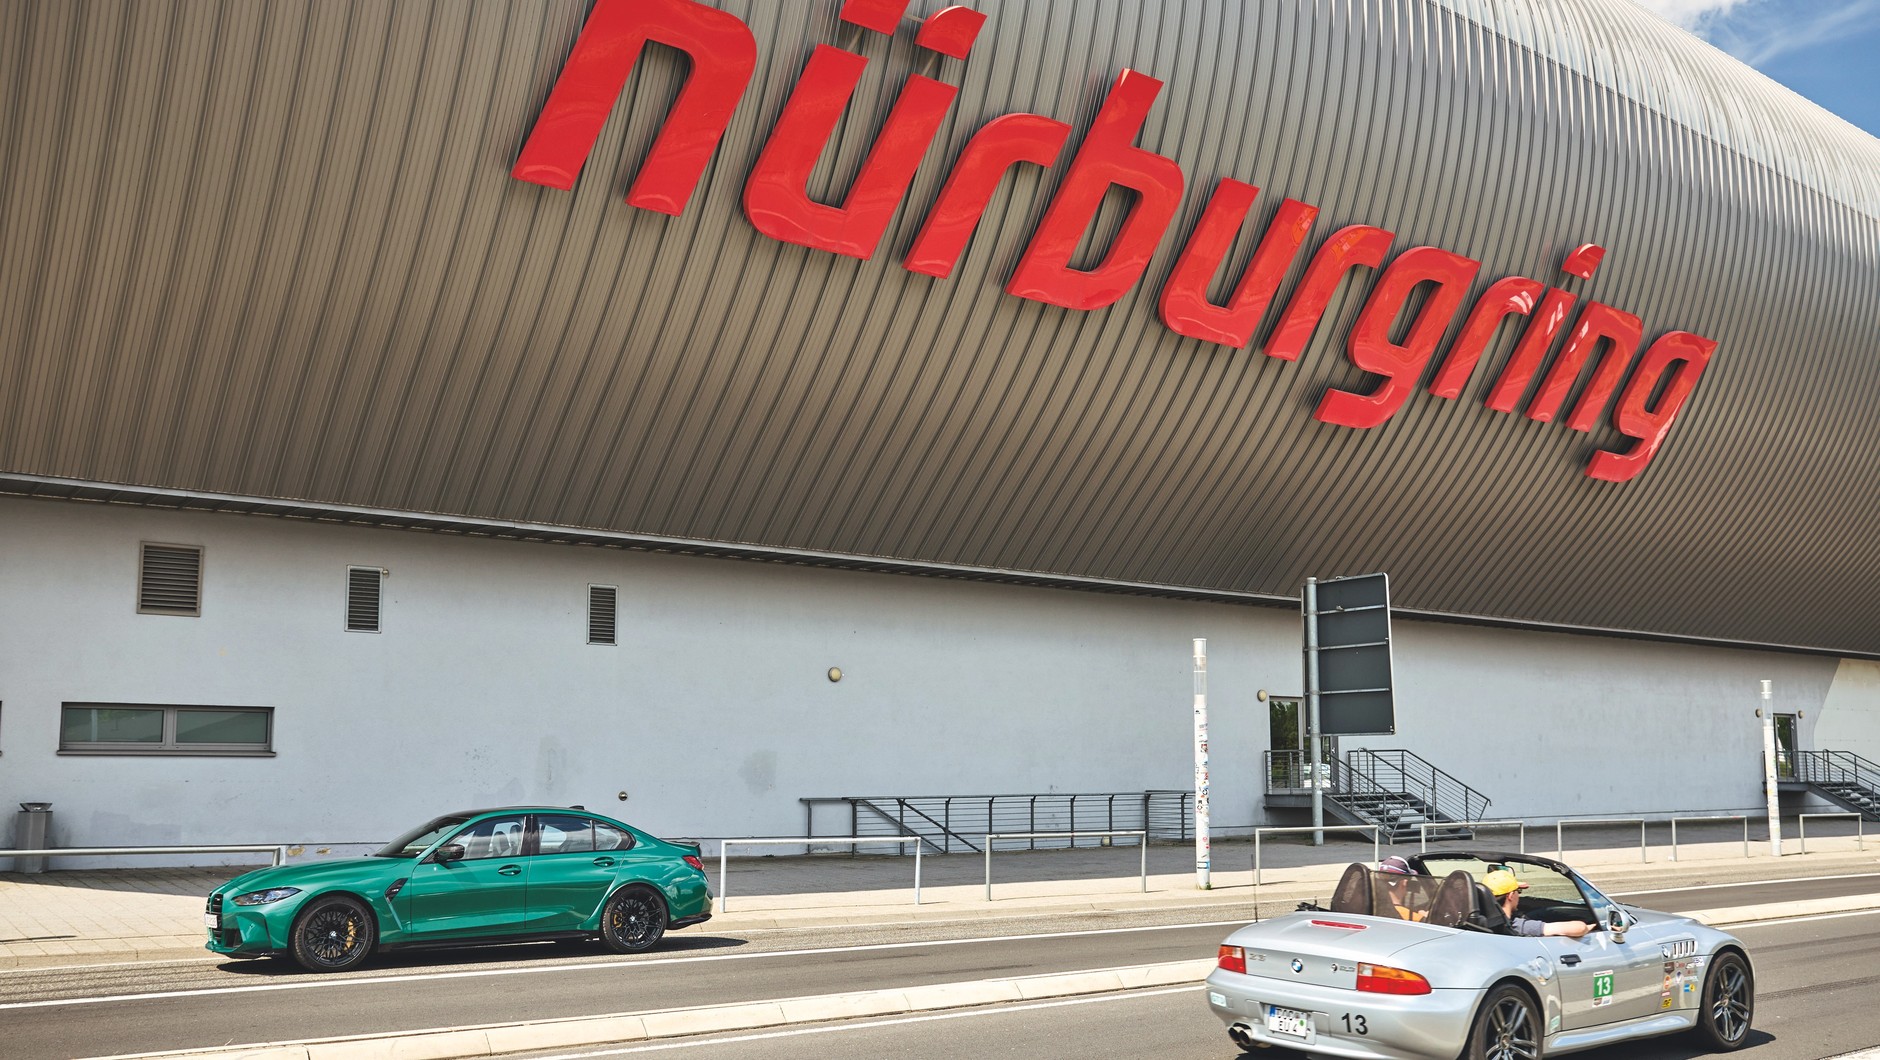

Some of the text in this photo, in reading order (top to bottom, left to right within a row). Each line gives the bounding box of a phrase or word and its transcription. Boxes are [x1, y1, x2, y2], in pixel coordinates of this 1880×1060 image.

[511, 0, 1718, 482] nürburgring
[1597, 977, 1611, 995] 13
[1341, 1012, 1369, 1035] 13
